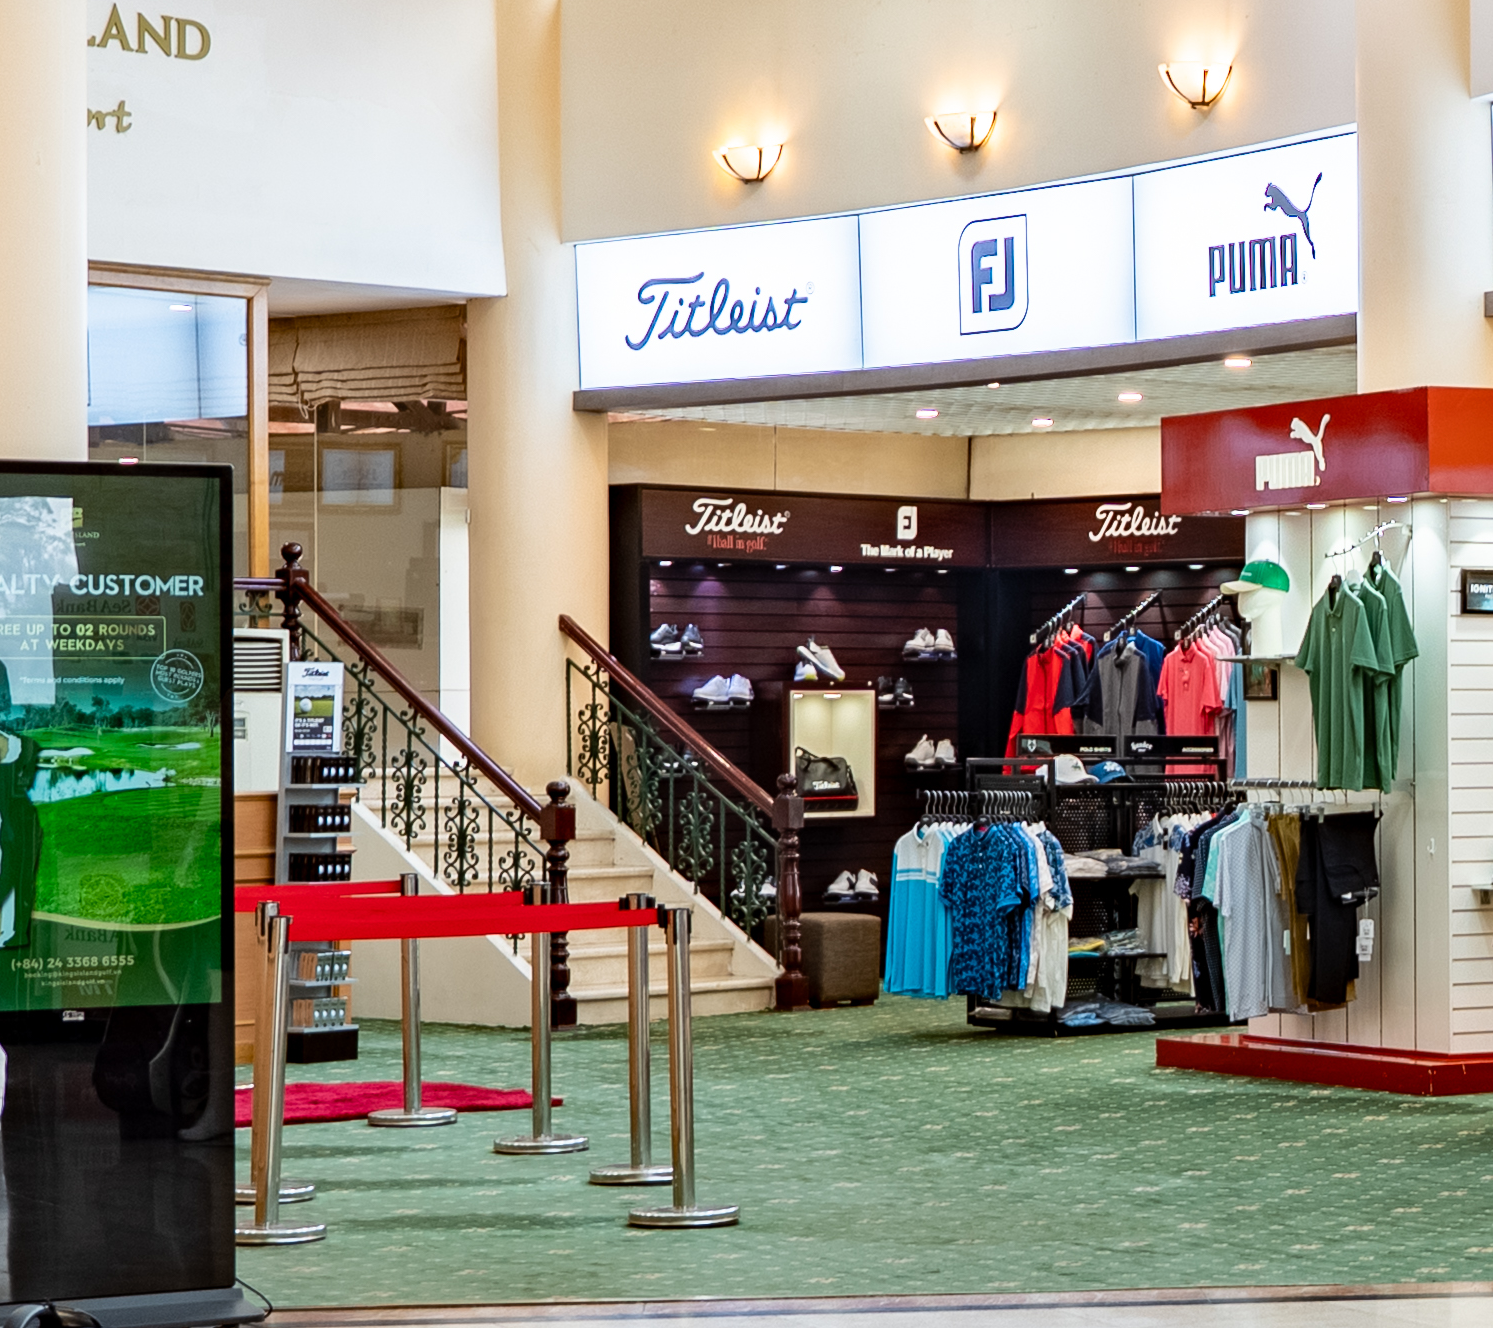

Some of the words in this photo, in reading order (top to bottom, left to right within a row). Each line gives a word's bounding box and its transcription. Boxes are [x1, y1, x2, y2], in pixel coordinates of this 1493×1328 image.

[970, 237, 1016, 313] FJ
[1208, 233, 1299, 298] PUMA
[624, 271, 809, 351] Titleist
[1255, 452, 1310, 491] PUMA
[685, 498, 786, 536] Titleist
[1088, 502, 1182, 542] Titleist
[860, 543, 881, 557] The
[881, 543, 904, 559] Mark
[905, 544, 915, 559] of
[924, 545, 954, 562] Player
[68, 574, 205, 598] CUSTOMER
[20, 639, 40, 651] AT
[46, 639, 125, 651] WEEKDAYS
[26, 623, 45, 637] UP
[52, 623, 72, 637] TO
[76, 623, 94, 637] 02
[99, 623, 156, 637] ROUNDS
[63, 676, 103, 685] conditions
[103, 677, 126, 686] apply
[11, 957, 44, 972] (+84)
[47, 957, 63, 969] 24
[67, 956, 99, 968] 3368
[102, 955, 135, 967] 6555
